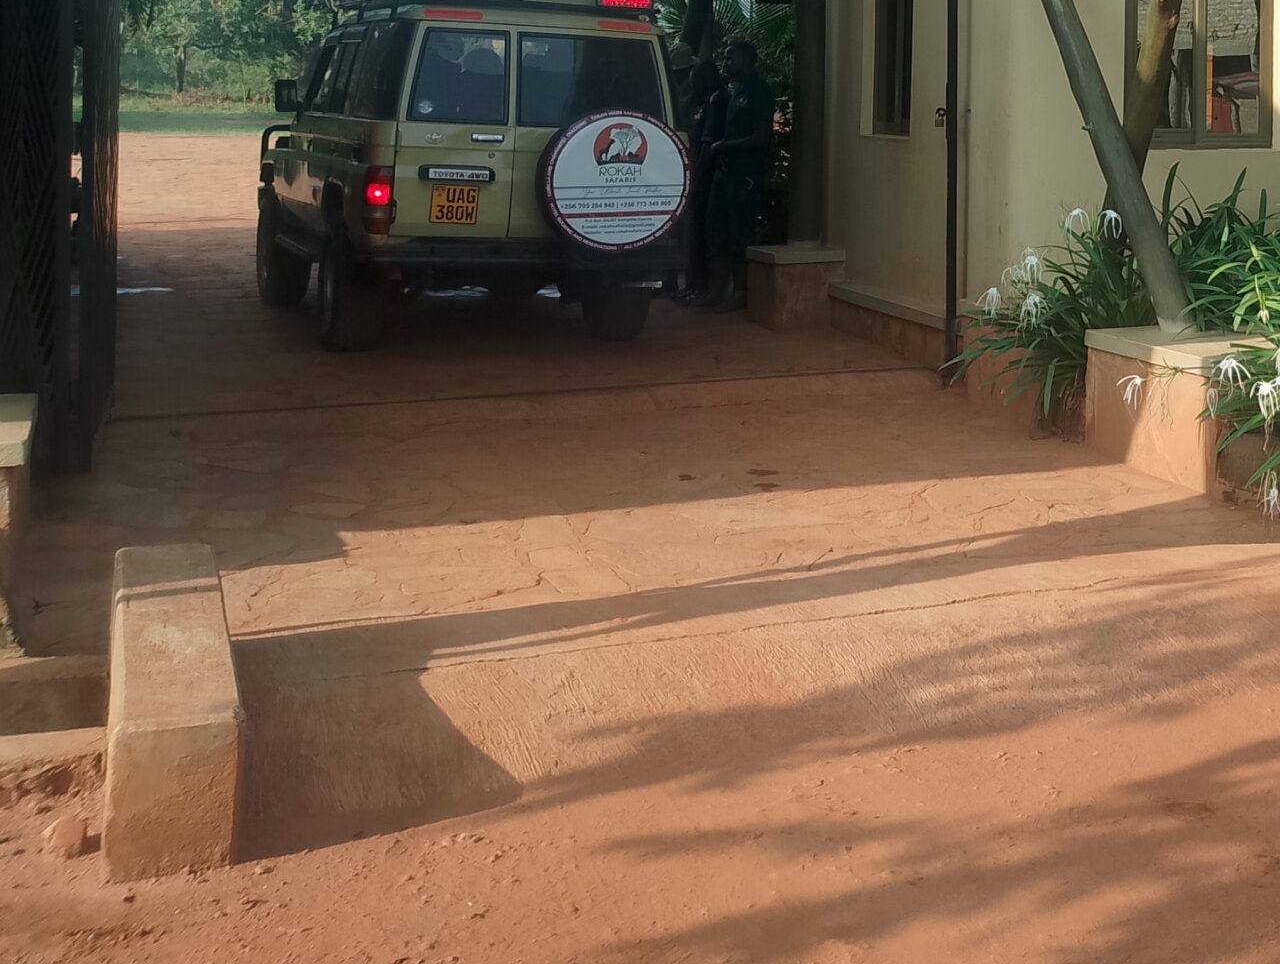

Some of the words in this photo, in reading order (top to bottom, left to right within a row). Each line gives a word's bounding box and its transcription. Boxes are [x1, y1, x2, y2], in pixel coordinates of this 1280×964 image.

[432, 170, 465, 178] TOYOTA
[598, 166, 642, 176] ROKAH
[446, 188, 477, 204] UAG
[435, 204, 475, 221] 380W
